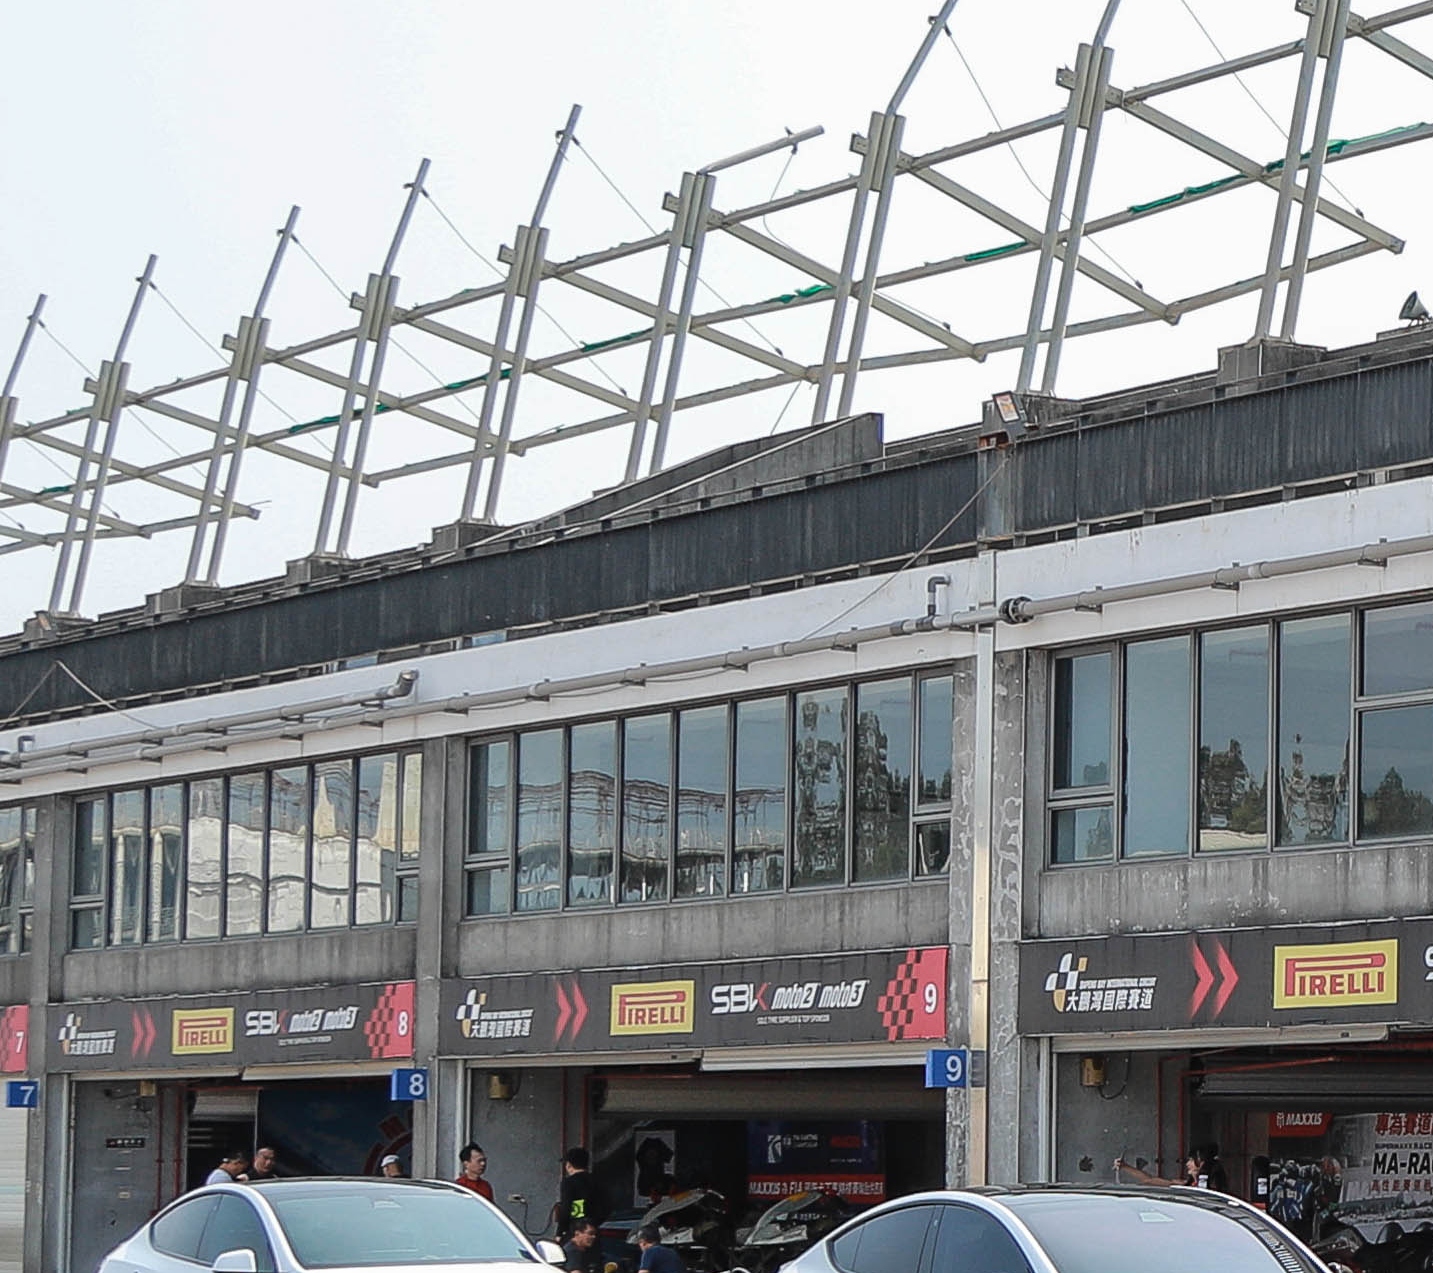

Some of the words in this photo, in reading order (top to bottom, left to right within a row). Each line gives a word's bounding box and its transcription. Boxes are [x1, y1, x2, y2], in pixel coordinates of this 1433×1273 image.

[1285, 953, 1386, 997] PIRELLI
[618, 991, 686, 1025] PIRELLI
[924, 984, 938, 1013] 9
[179, 1017, 227, 1046] PIRELLI
[398, 1011, 408, 1036] 8
[16, 1031, 24, 1054] 7
[946, 1055, 962, 1081] 9
[20, 1086, 34, 1105] 7
[409, 1073, 424, 1096] 8
[1286, 1112, 1323, 1126] MAXXIS
